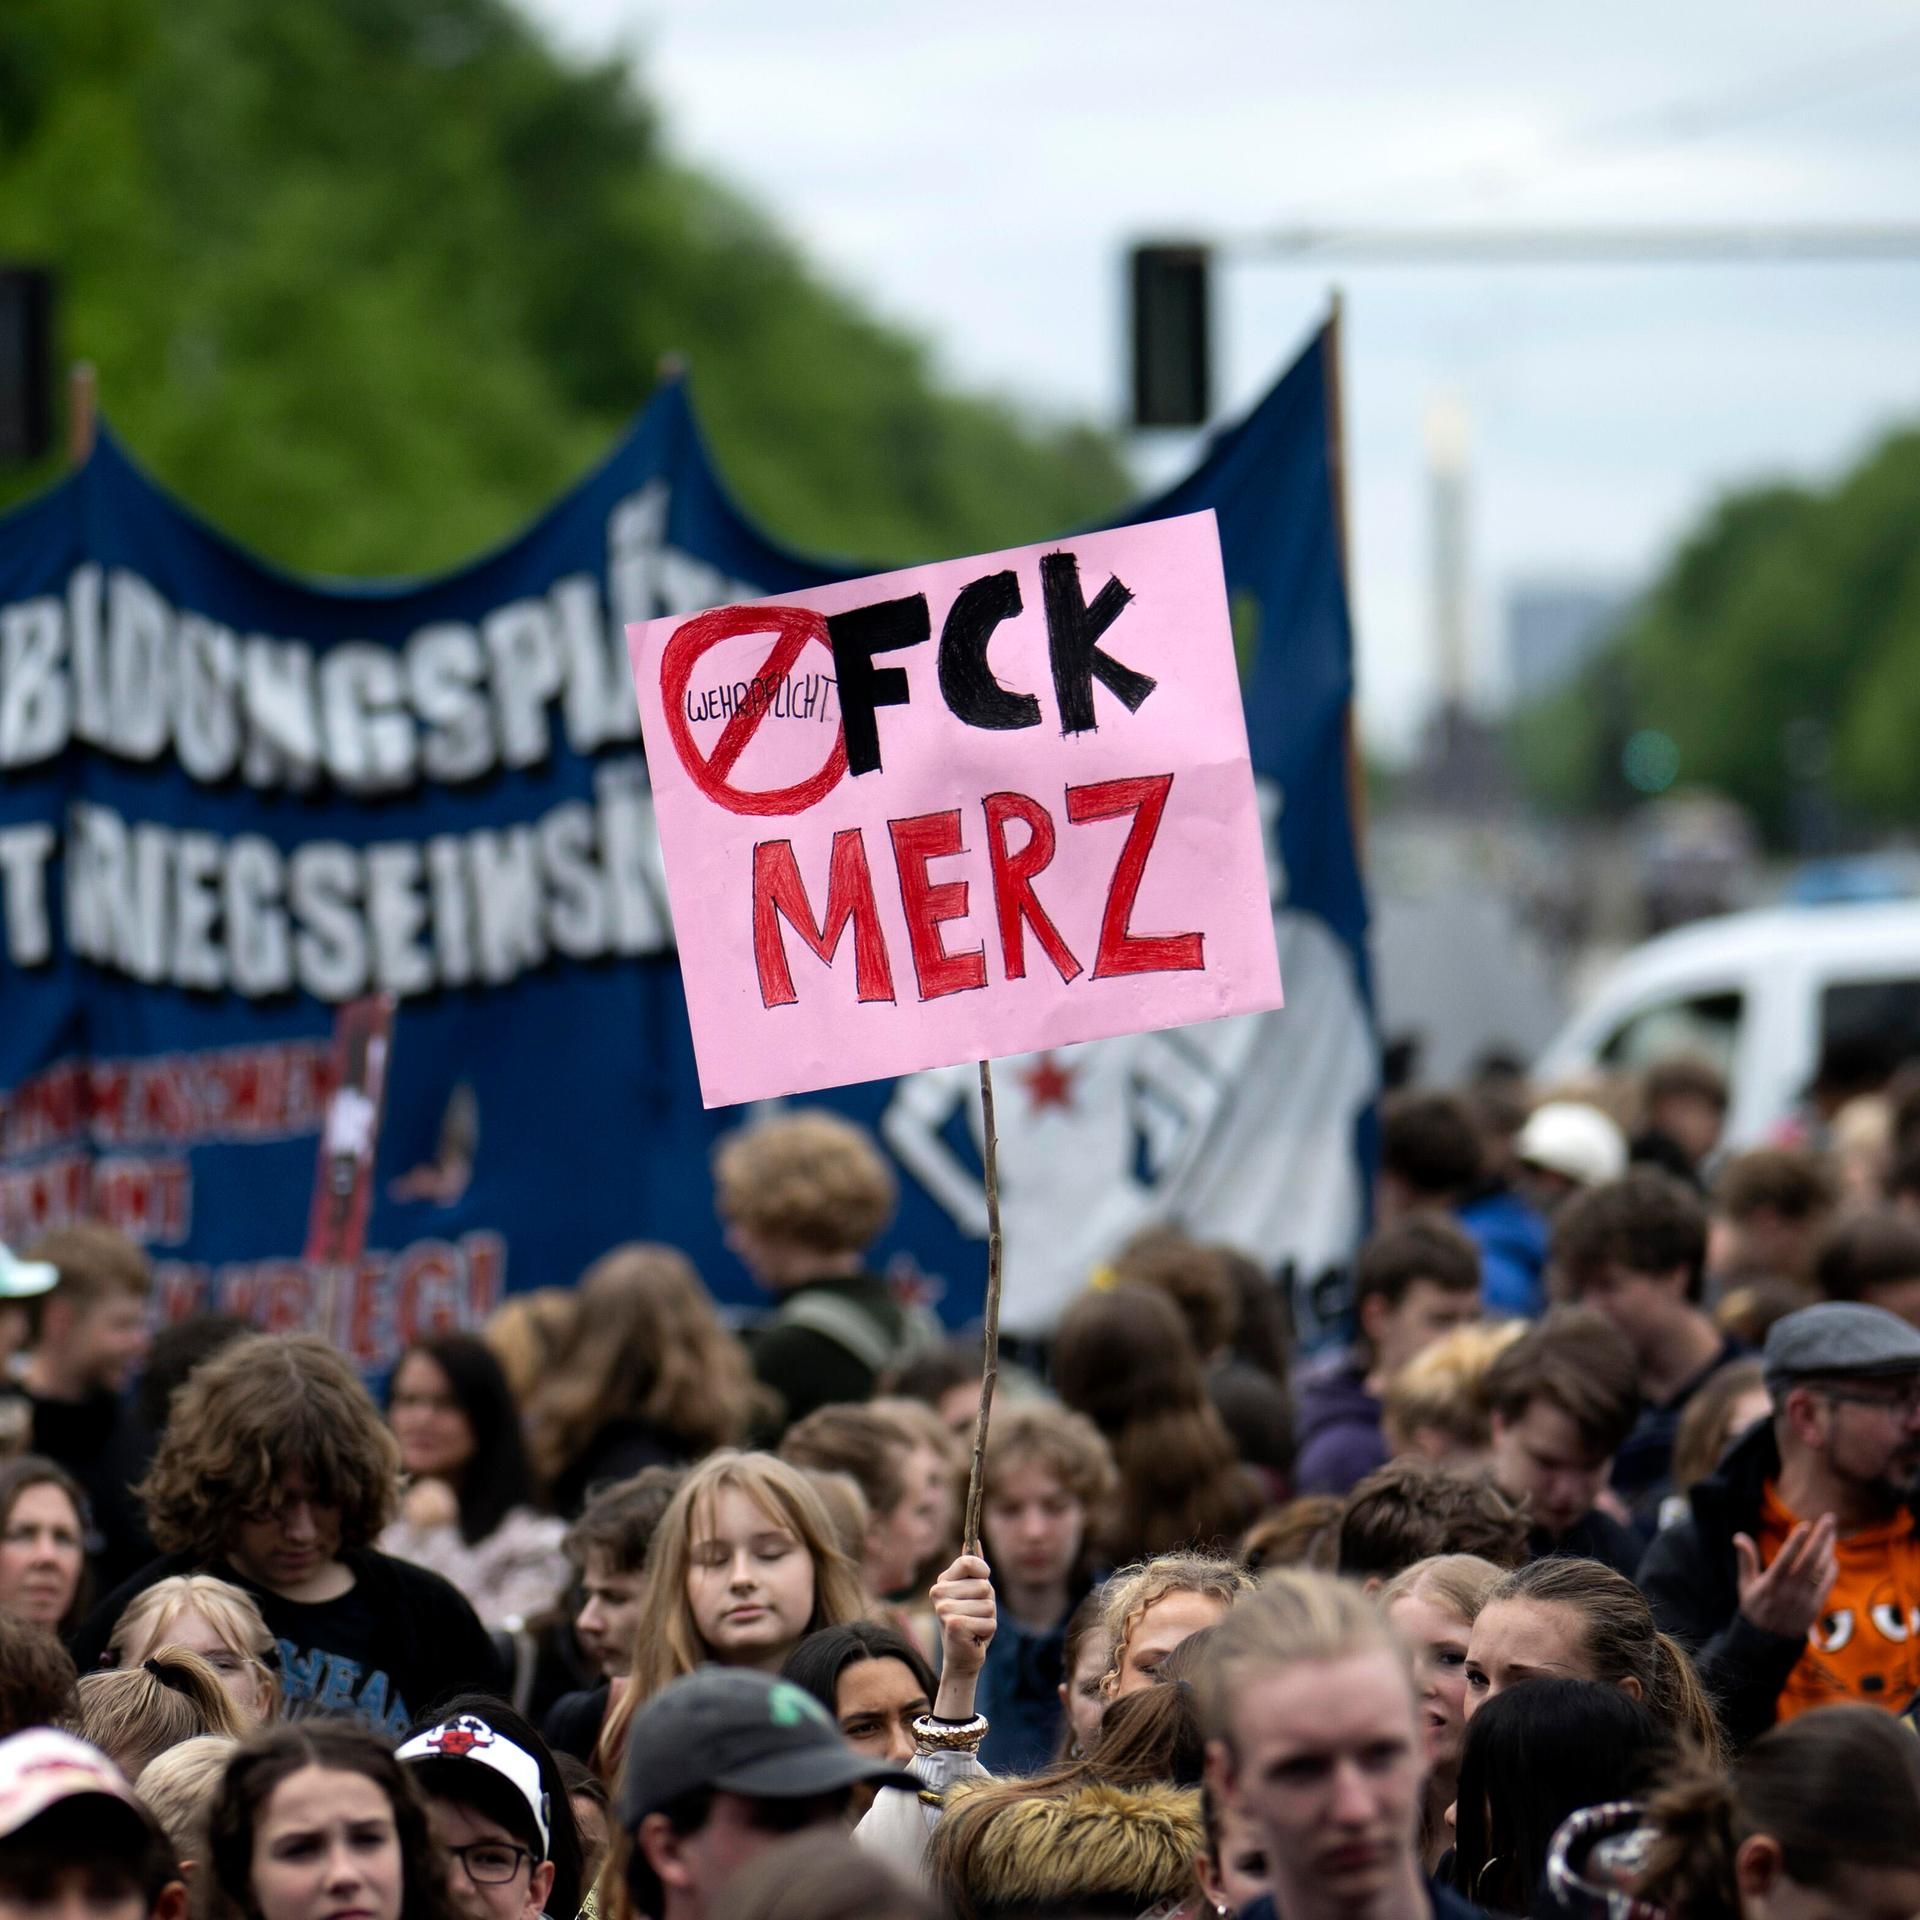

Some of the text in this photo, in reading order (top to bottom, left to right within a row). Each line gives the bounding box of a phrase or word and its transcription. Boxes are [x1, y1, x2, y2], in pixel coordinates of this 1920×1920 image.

[687, 672, 839, 723] WEHRPFLICHT
[825, 548, 1158, 778] FCK
[751, 773, 1206, 1010] MERZ
